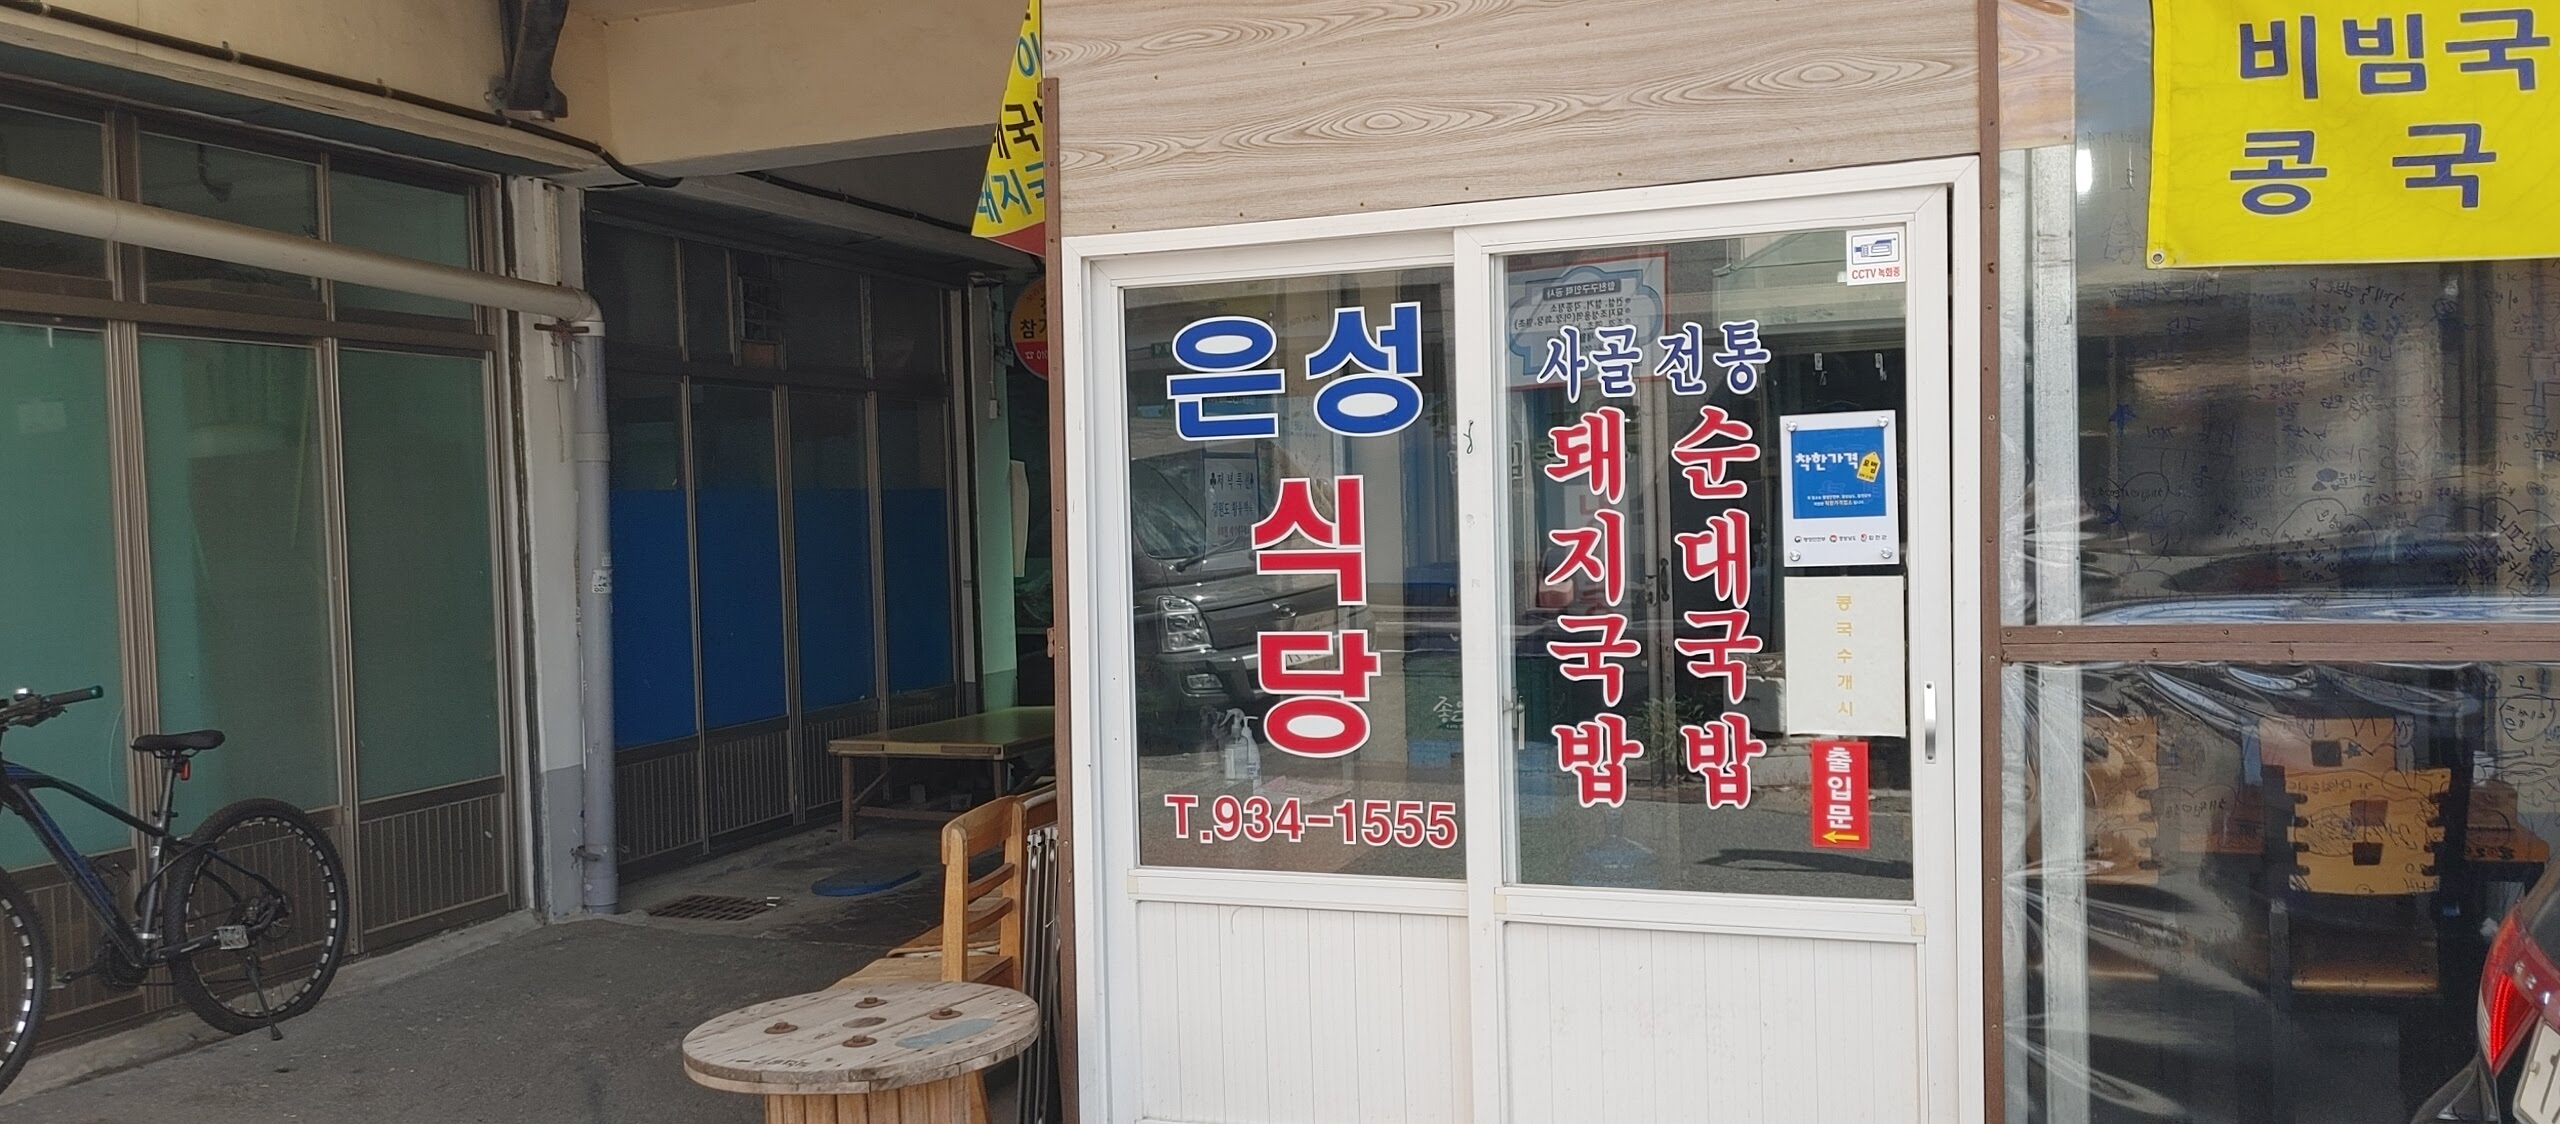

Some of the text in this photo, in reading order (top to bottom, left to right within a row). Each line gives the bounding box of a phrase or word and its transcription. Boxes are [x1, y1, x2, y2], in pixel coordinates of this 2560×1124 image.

[1851, 266, 1901, 280] CCTV 녹화중
[1167, 302, 1424, 442] 은성
[1795, 451, 1859, 472] 착한가격
[1252, 475, 1382, 757] 식당
[1536, 325, 1644, 809] 사골 돼지국밥
[1654, 319, 1772, 810] 전통 순대국밥
[1165, 793, 1459, 849] T.934-1555
[1825, 746, 1855, 830] 출입문
